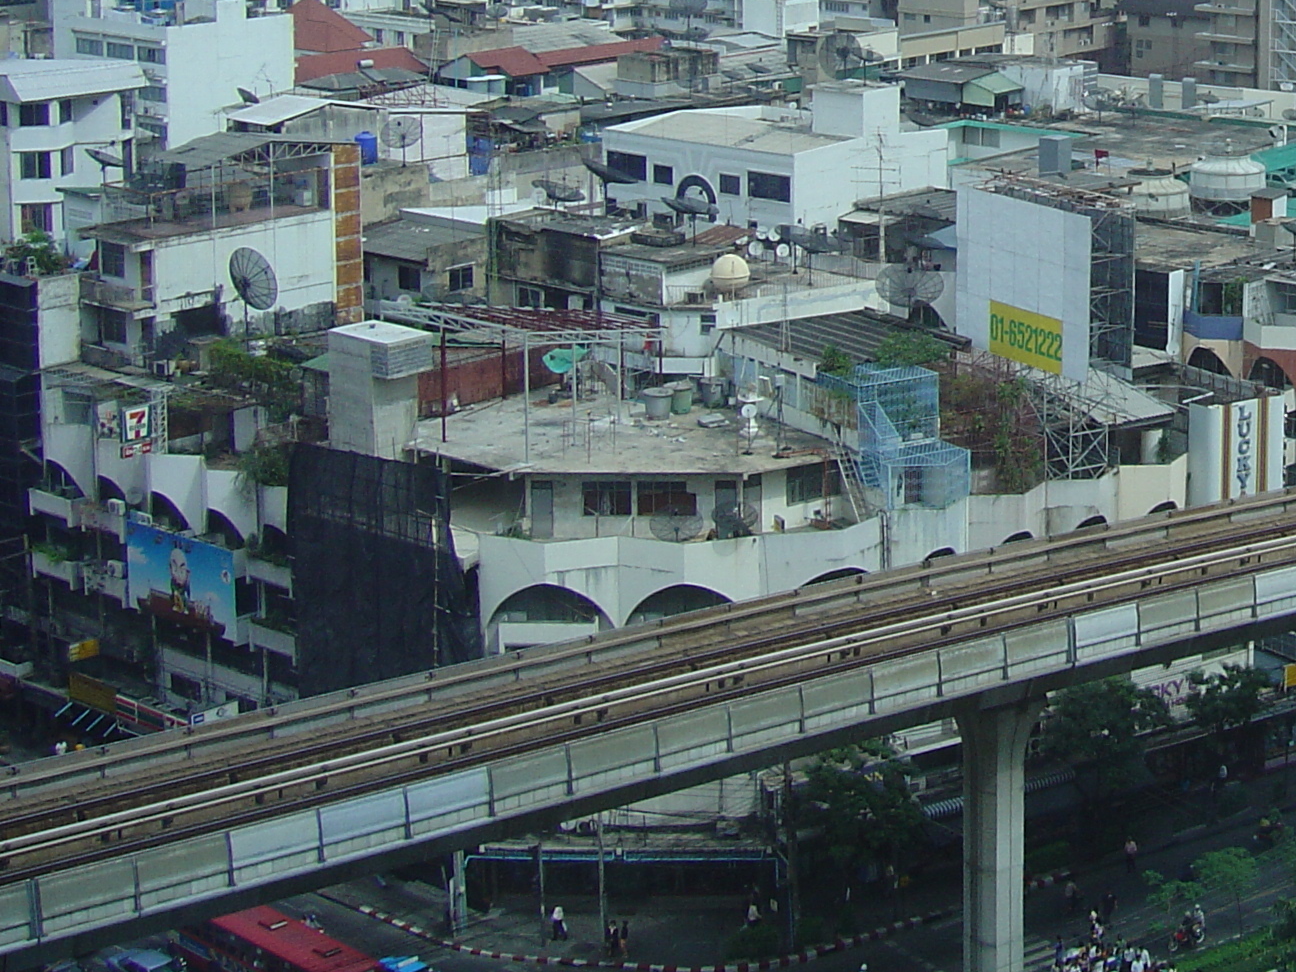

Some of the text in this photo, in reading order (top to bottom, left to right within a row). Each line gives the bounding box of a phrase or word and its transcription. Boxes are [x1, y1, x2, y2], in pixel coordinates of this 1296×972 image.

[989, 313, 1063, 362] 01-6521222
[129, 409, 146, 439] 7
[1236, 404, 1252, 490] LUCKY
